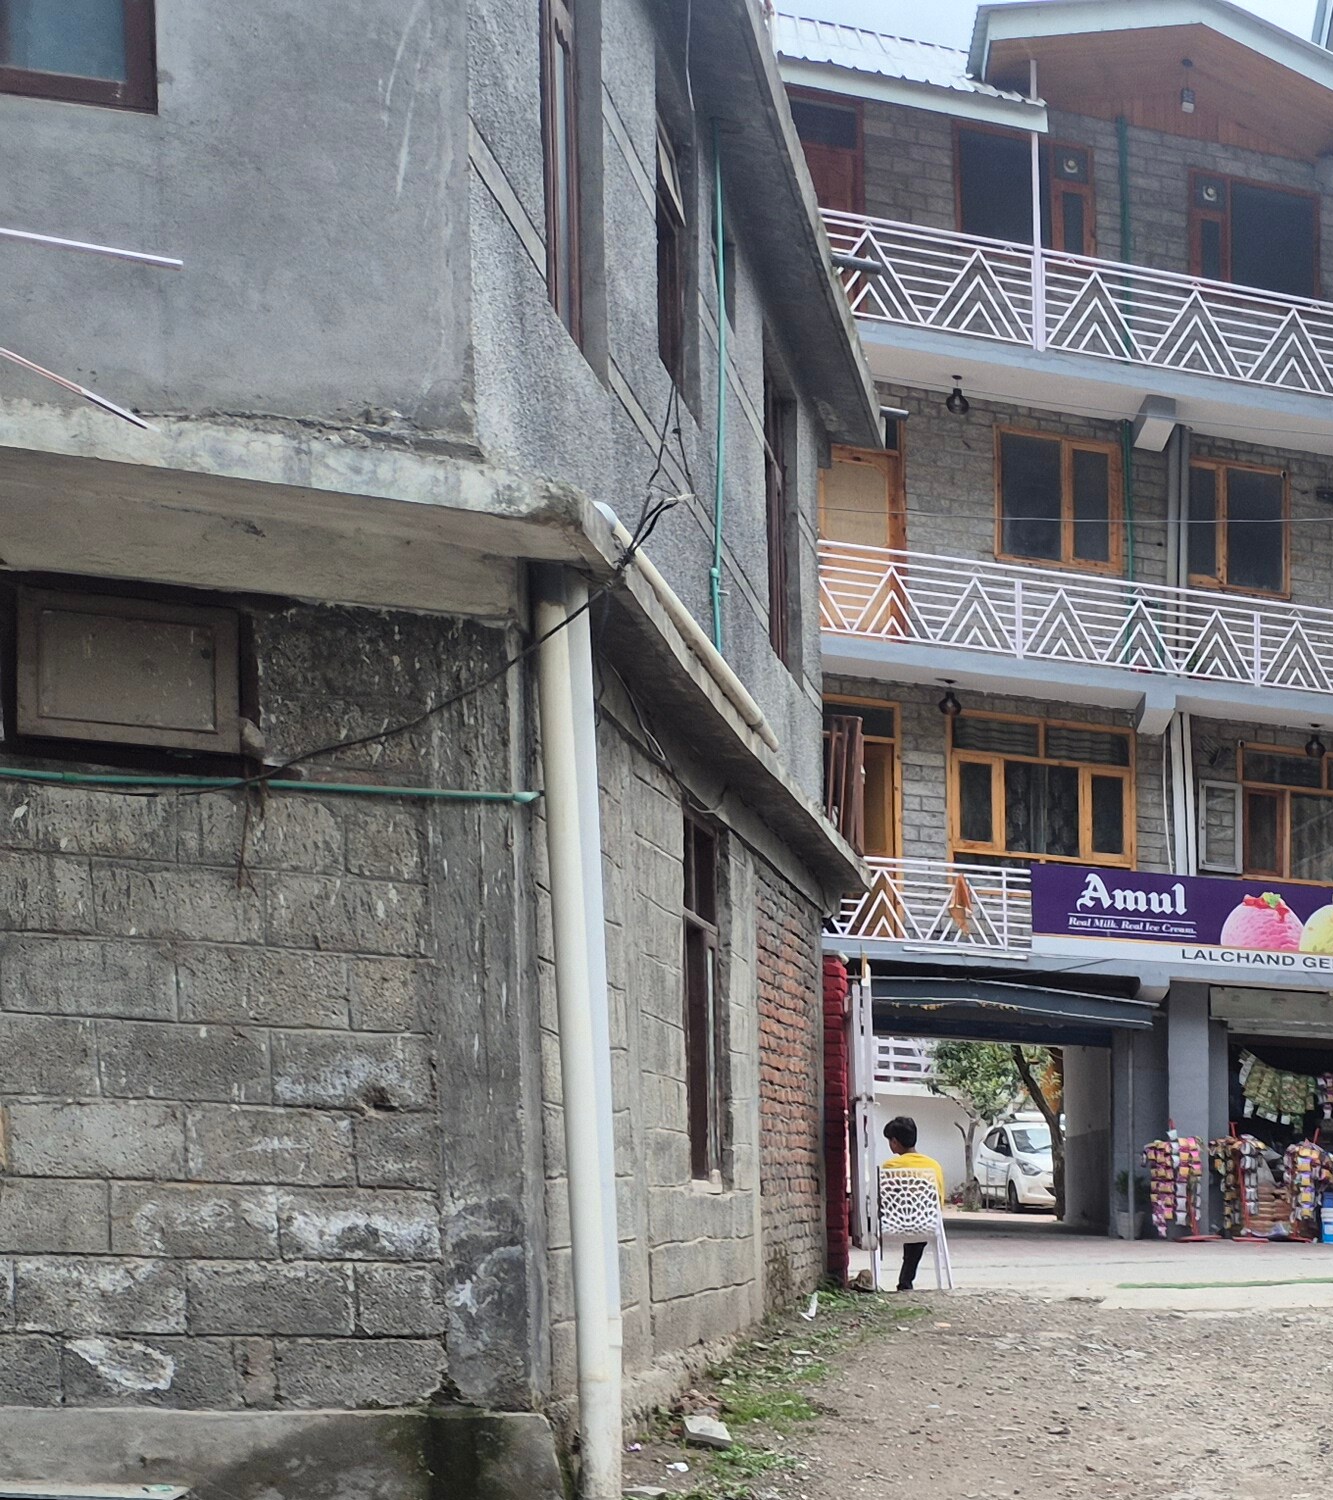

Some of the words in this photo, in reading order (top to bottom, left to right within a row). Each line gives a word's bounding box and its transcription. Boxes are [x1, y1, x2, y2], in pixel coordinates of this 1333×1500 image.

[1076, 873, 1187, 915] Amul
[1068, 916, 1091, 927] Real
[1121, 922, 1143, 931] Real
[1145, 923, 1160, 932] Ice
[1181, 949, 1295, 967] LALCHAND
